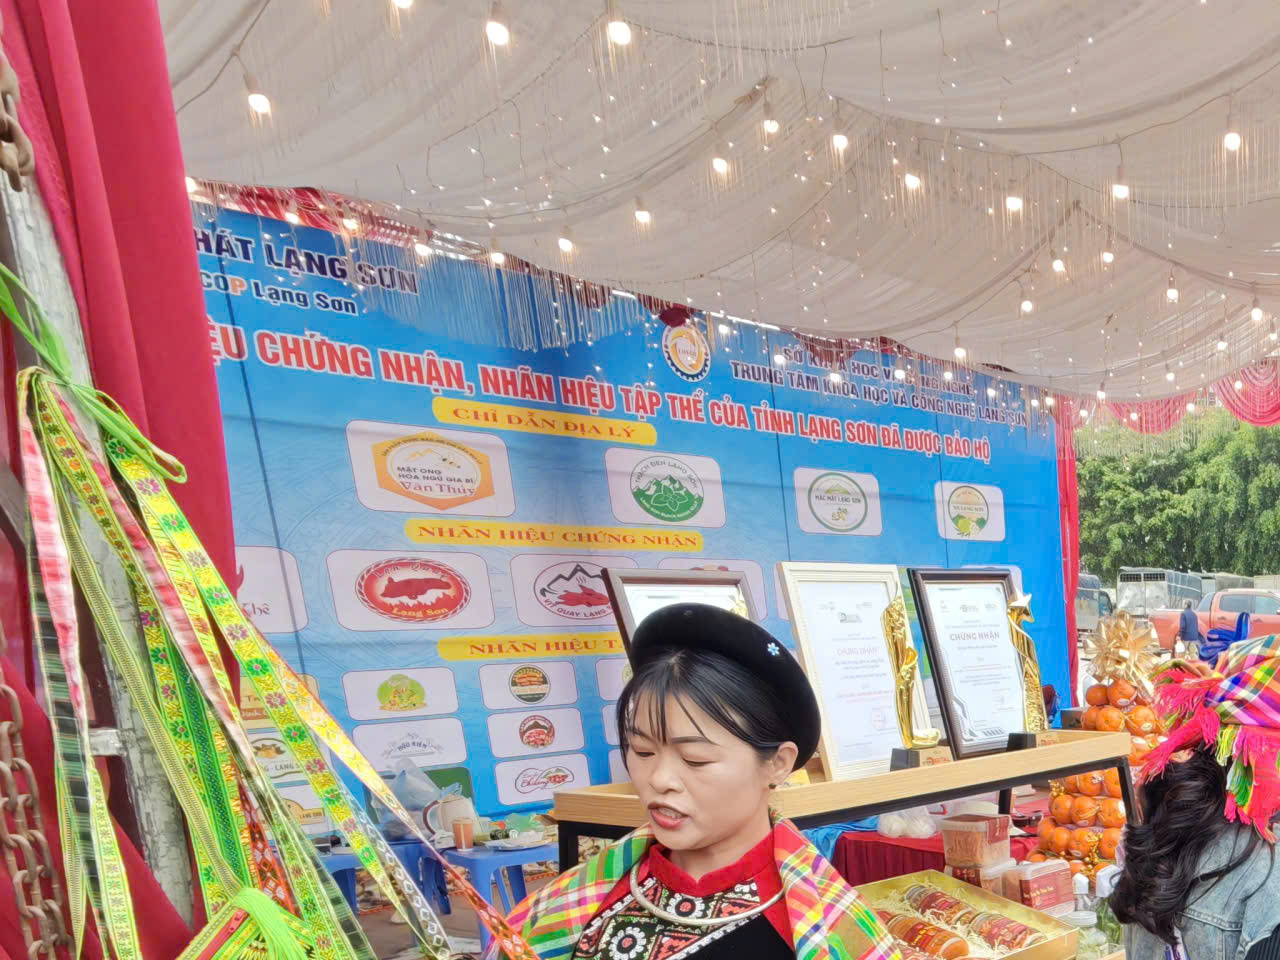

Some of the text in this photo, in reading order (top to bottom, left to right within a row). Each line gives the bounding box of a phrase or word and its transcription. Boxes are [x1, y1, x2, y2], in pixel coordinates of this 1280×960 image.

[265, 242, 347, 279] LẠNG
[356, 262, 418, 294] SƠN
[201, 272, 357, 314] COP Lạng Sơn
[256, 330, 374, 378] CHỨNG
[379, 350, 473, 393] NHẬN,
[480, 366, 555, 402] NHÃN
[560, 376, 615, 413] HIỆU
[619, 384, 662, 419] TẬP
[666, 389, 705, 422] THỂ
[709, 395, 750, 428] CỦA
[753, 402, 795, 433] TỈNH
[800, 416, 841, 441] LẠNG
[846, 423, 878, 446] SƠN
[881, 425, 900, 447] ĐÃ
[905, 431, 941, 456] ĐƯỢC
[945, 431, 971, 457] BẢO
[974, 436, 991, 462] HỘ
[731, 361, 783, 384] TRUNG
[787, 369, 819, 391] TÂM
[863, 386, 889, 405] HỌC
[563, 420, 601, 436] ĐỊA
[608, 426, 635, 439] LÝ
[418, 524, 698, 548] NHÃN HIỆU CHỨNG NHẬN
[470, 641, 537, 654] NHÃN
[545, 638, 598, 653] HIỆU
